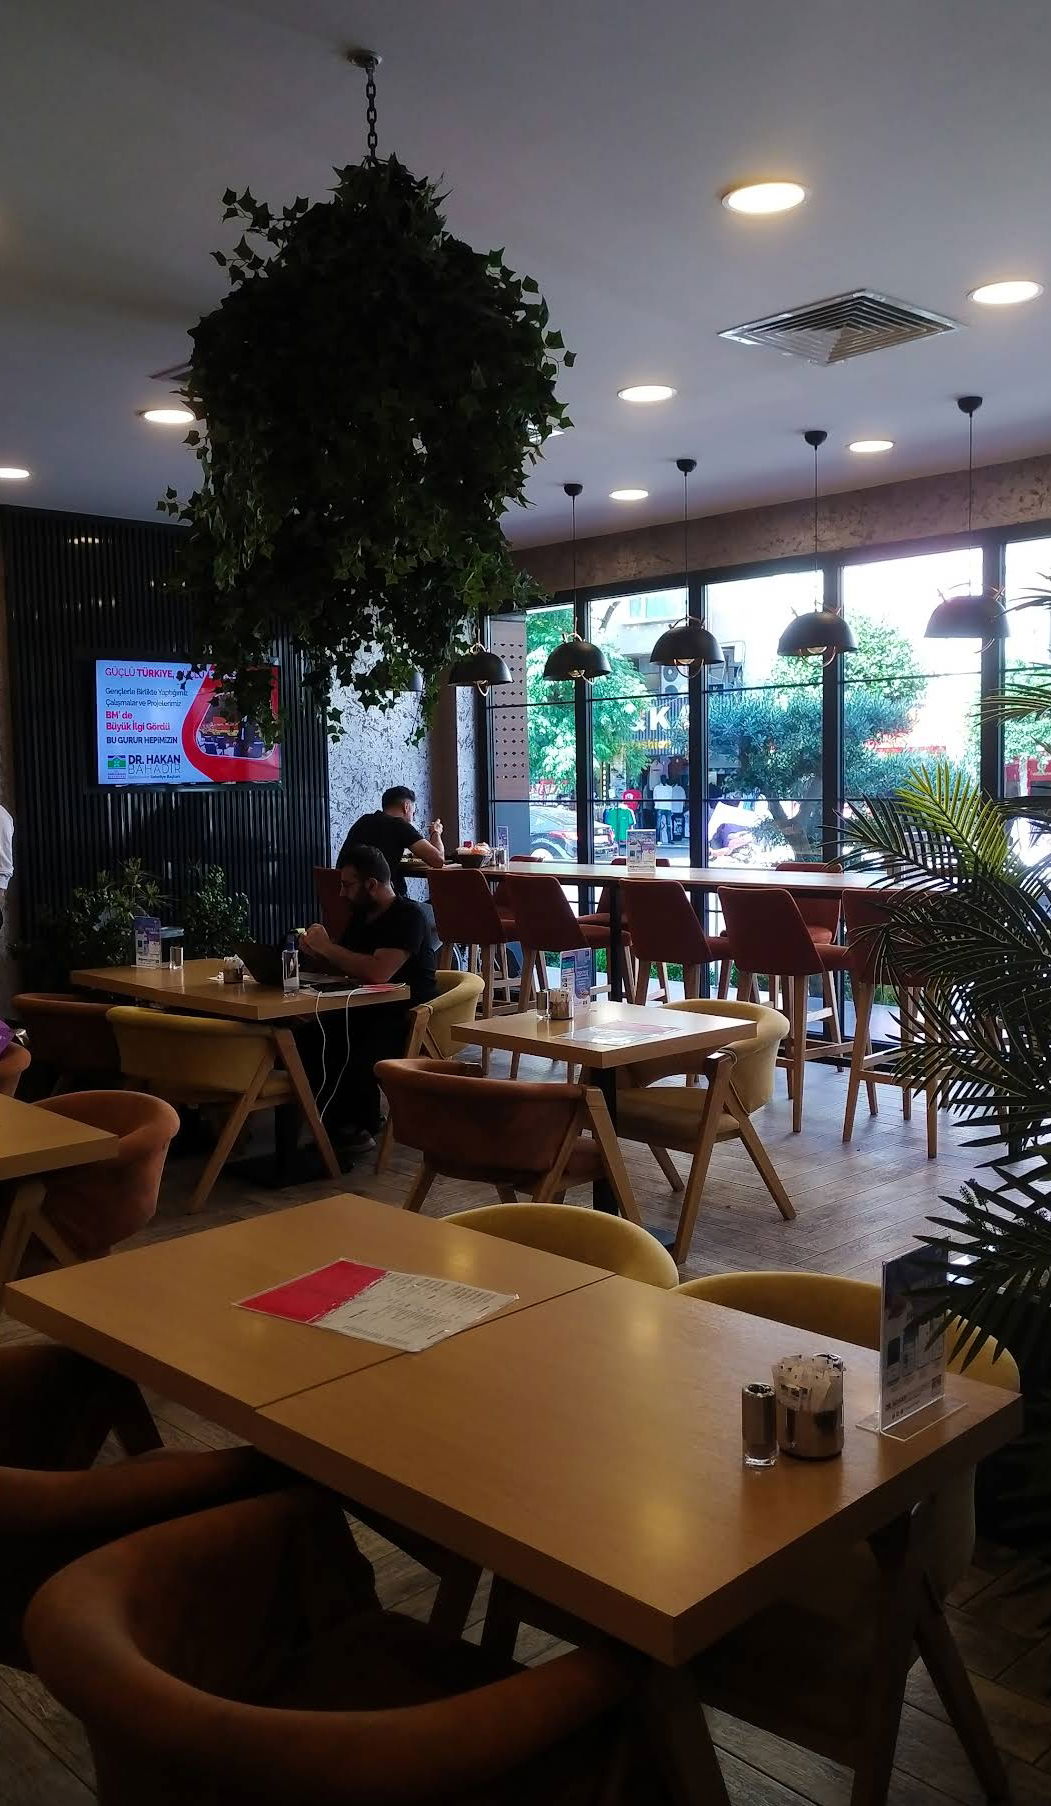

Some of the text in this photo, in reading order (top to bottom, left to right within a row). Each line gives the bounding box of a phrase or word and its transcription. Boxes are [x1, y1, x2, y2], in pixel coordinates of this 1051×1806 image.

[105, 666, 135, 679] GÜÇLÜ
[136, 688, 158, 696] Birlikte
[106, 722, 131, 732] Büyük
[146, 722, 171, 731] Gördü
[106, 736, 117, 744] BU
[117, 736, 143, 744] GURUR
[128, 754, 181, 765] DR. HAKAN
[128, 764, 182, 775] BAHADIR
